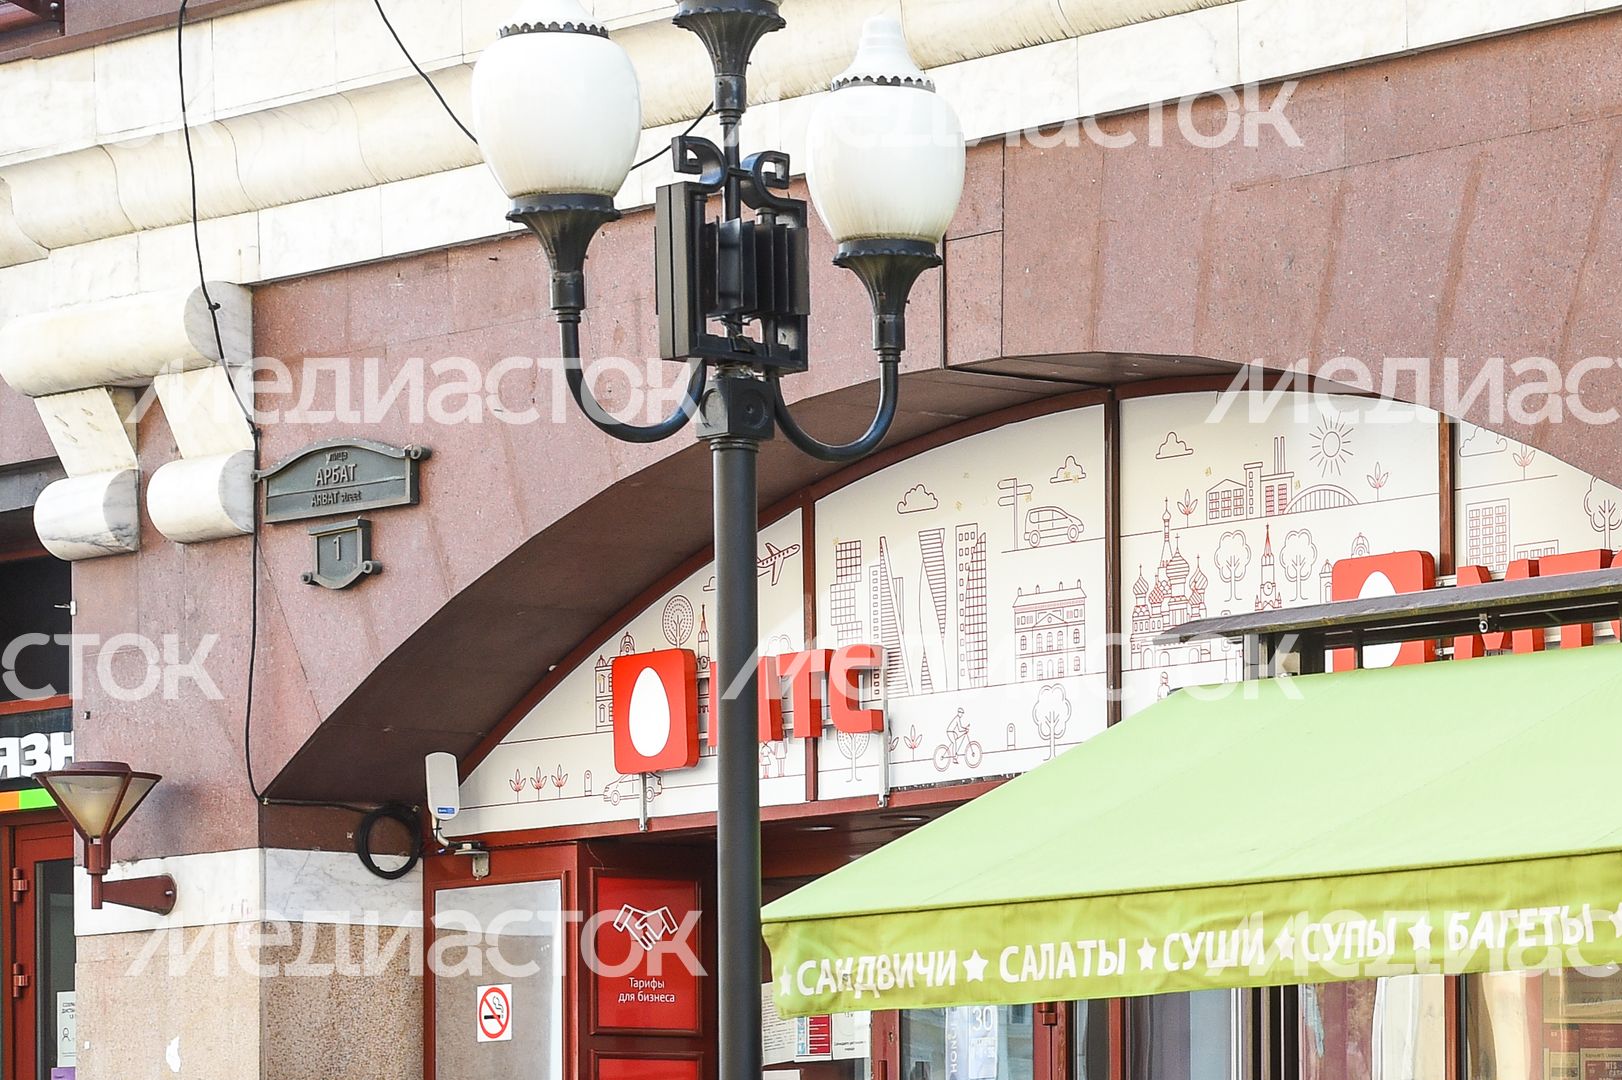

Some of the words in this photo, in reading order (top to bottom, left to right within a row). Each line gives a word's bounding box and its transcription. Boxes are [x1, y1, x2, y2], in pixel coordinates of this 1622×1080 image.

[315, 464, 357, 486] АРБАТ
[311, 493, 340, 507] ARBAT
[341, 490, 362, 503] street
[333, 534, 342, 561] 1
[797, 950, 956, 999] САНДВИЧИ
[999, 938, 1126, 983] САЛАТЫ
[1162, 926, 1265, 970] СУШИ
[1301, 917, 1397, 963] СУПЫ
[1448, 903, 1594, 951] БАГЕТЫ
[629, 977, 665, 990] Тарифы
[618, 992, 635, 1003] для
[637, 990, 675, 1003] бизнеса
